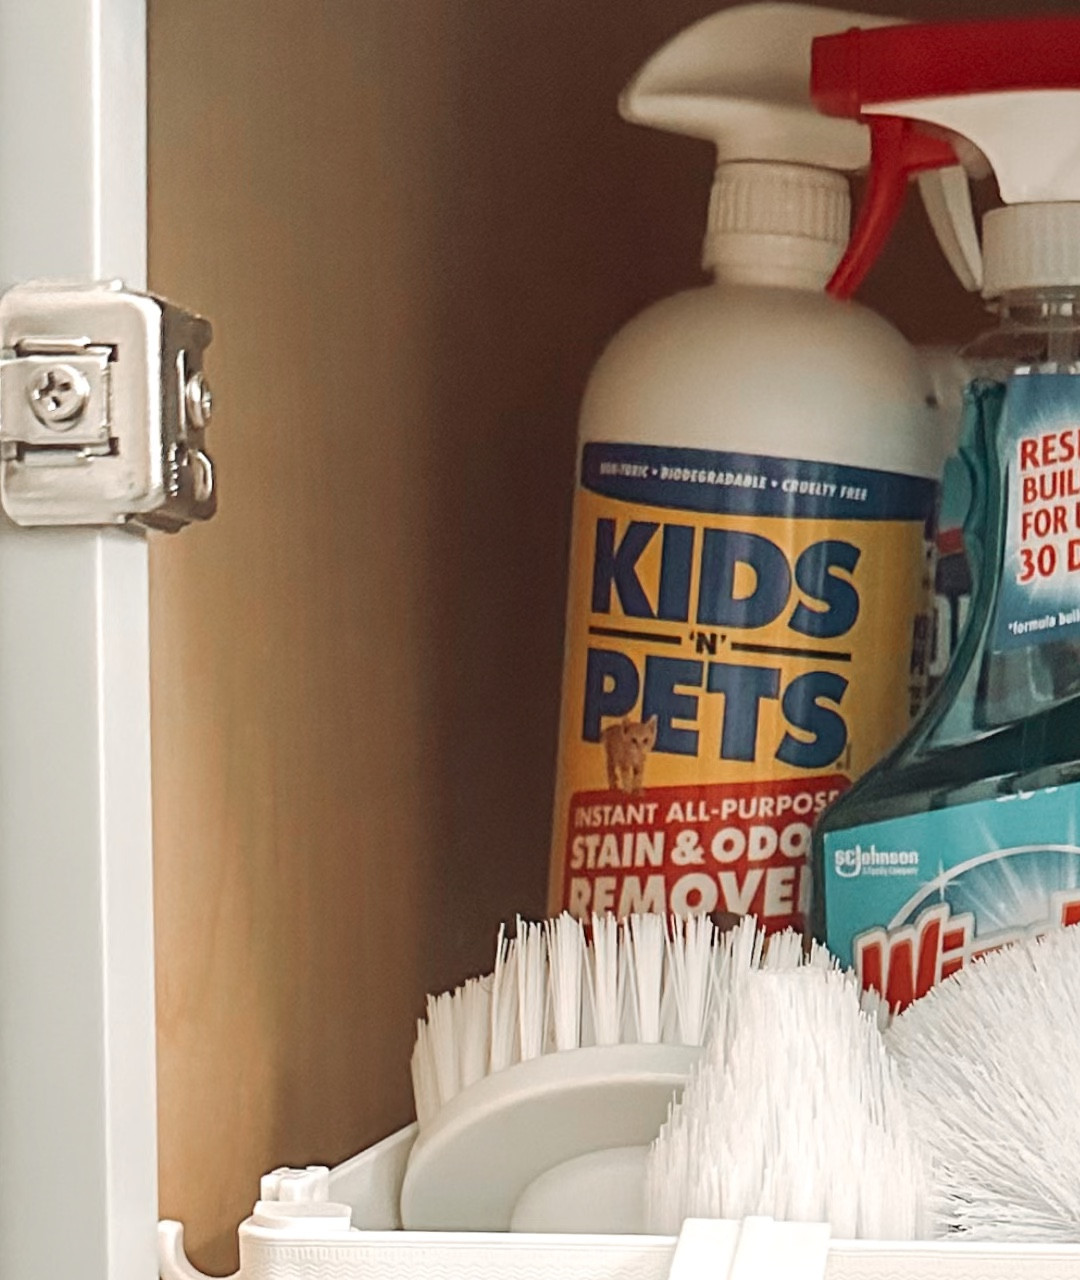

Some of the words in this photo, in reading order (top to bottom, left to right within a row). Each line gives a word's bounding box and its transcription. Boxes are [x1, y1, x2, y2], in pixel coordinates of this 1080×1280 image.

[660, 466, 766, 490] BIODEGRADABLE
[781, 478, 836, 499] CRUELTY
[840, 485, 868, 502] FREE
[1021, 505, 1068, 541] FOR
[590, 517, 862, 639] KIDS
[1019, 544, 1057, 582] 30
[582, 647, 850, 770] PETS
[575, 802, 659, 828] INSTANT
[569, 830, 666, 870] STAIN
[670, 828, 706, 866] &
